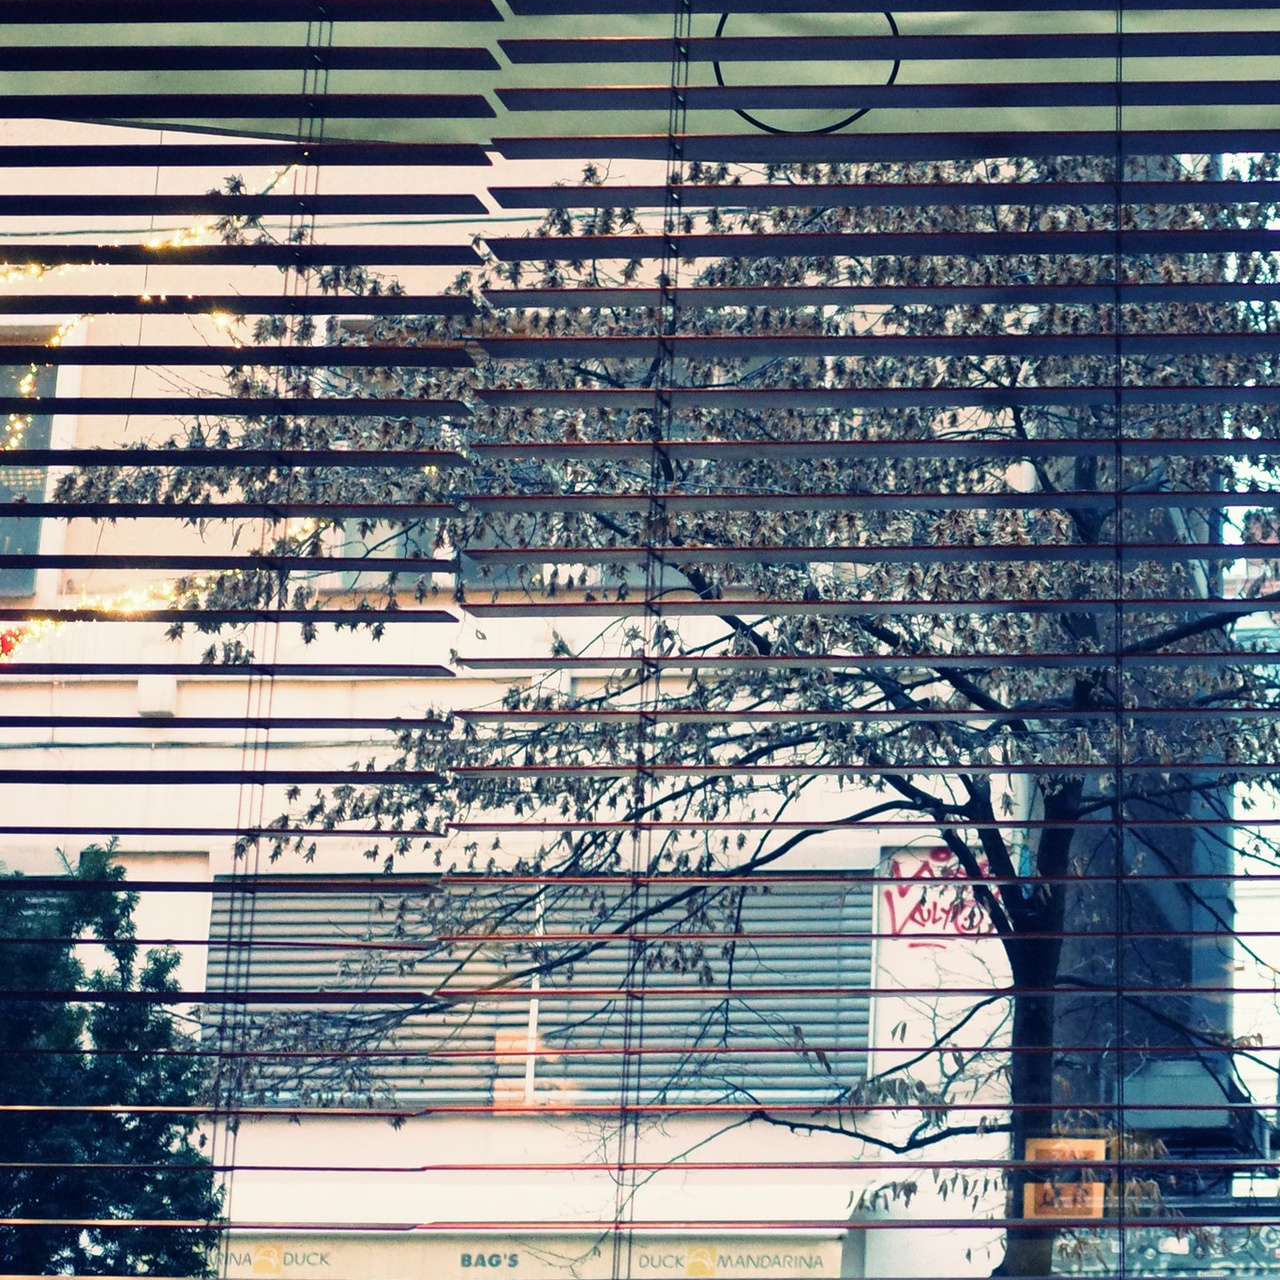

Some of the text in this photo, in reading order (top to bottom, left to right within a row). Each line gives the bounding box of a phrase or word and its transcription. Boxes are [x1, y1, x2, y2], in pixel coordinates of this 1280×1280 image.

[282, 1252, 330, 1267] DUCK
[460, 1253, 519, 1268] BAG'S
[638, 1253, 824, 1269] DUCK MANDARINA
